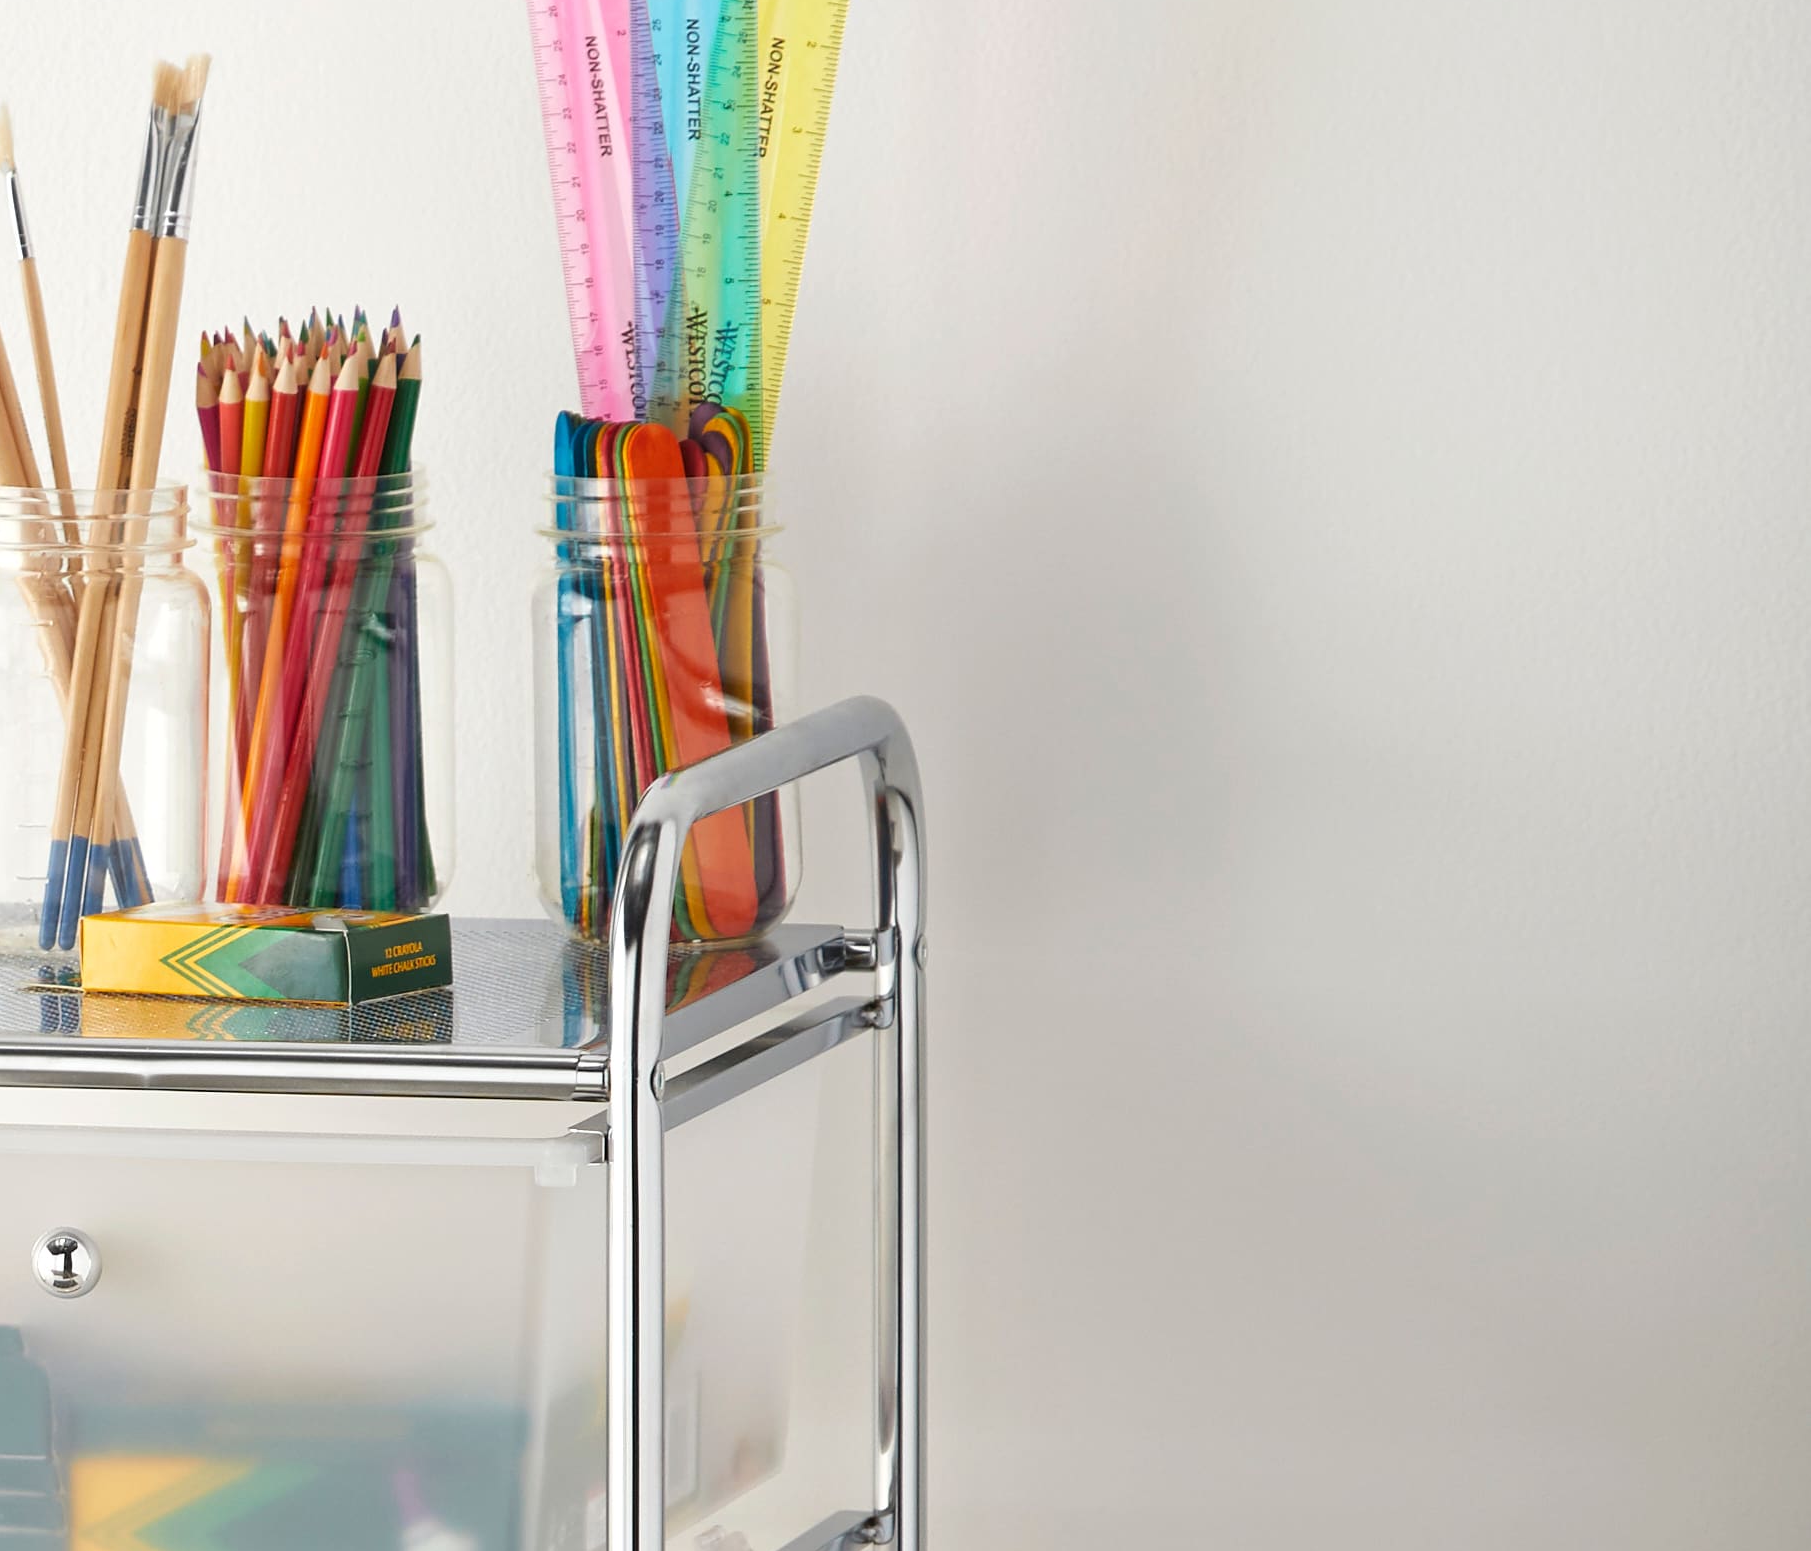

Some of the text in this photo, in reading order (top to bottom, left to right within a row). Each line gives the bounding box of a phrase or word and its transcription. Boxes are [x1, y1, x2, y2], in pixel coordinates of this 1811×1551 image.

[585, 35, 613, 157] NON-SHATTER
[686, 19, 701, 140] NON-SHATTER
[686, 312, 707, 413] WESTCOT
[707, 327, 739, 405] WESTCO
[371, 954, 436, 978] WHITE CHALK STICKS
[393, 941, 423, 957] CRAYOLA
